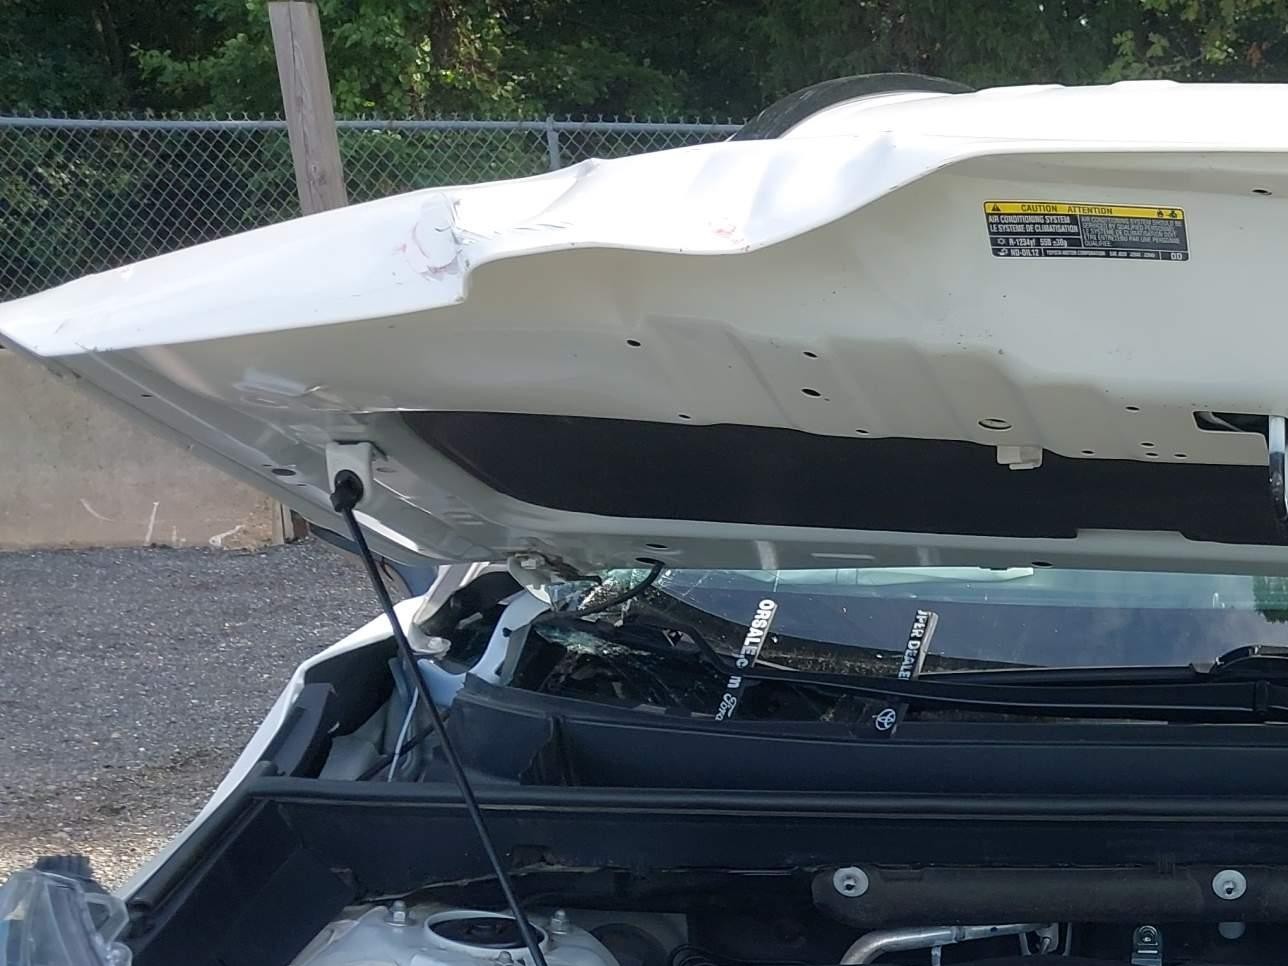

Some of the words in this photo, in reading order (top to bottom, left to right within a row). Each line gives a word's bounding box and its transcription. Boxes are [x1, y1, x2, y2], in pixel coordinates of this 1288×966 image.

[1067, 206, 1113, 214] ATTENTION
[1000, 216, 1044, 224] CONDITIONING
[1035, 224, 1078, 232] CLIMATISATION
